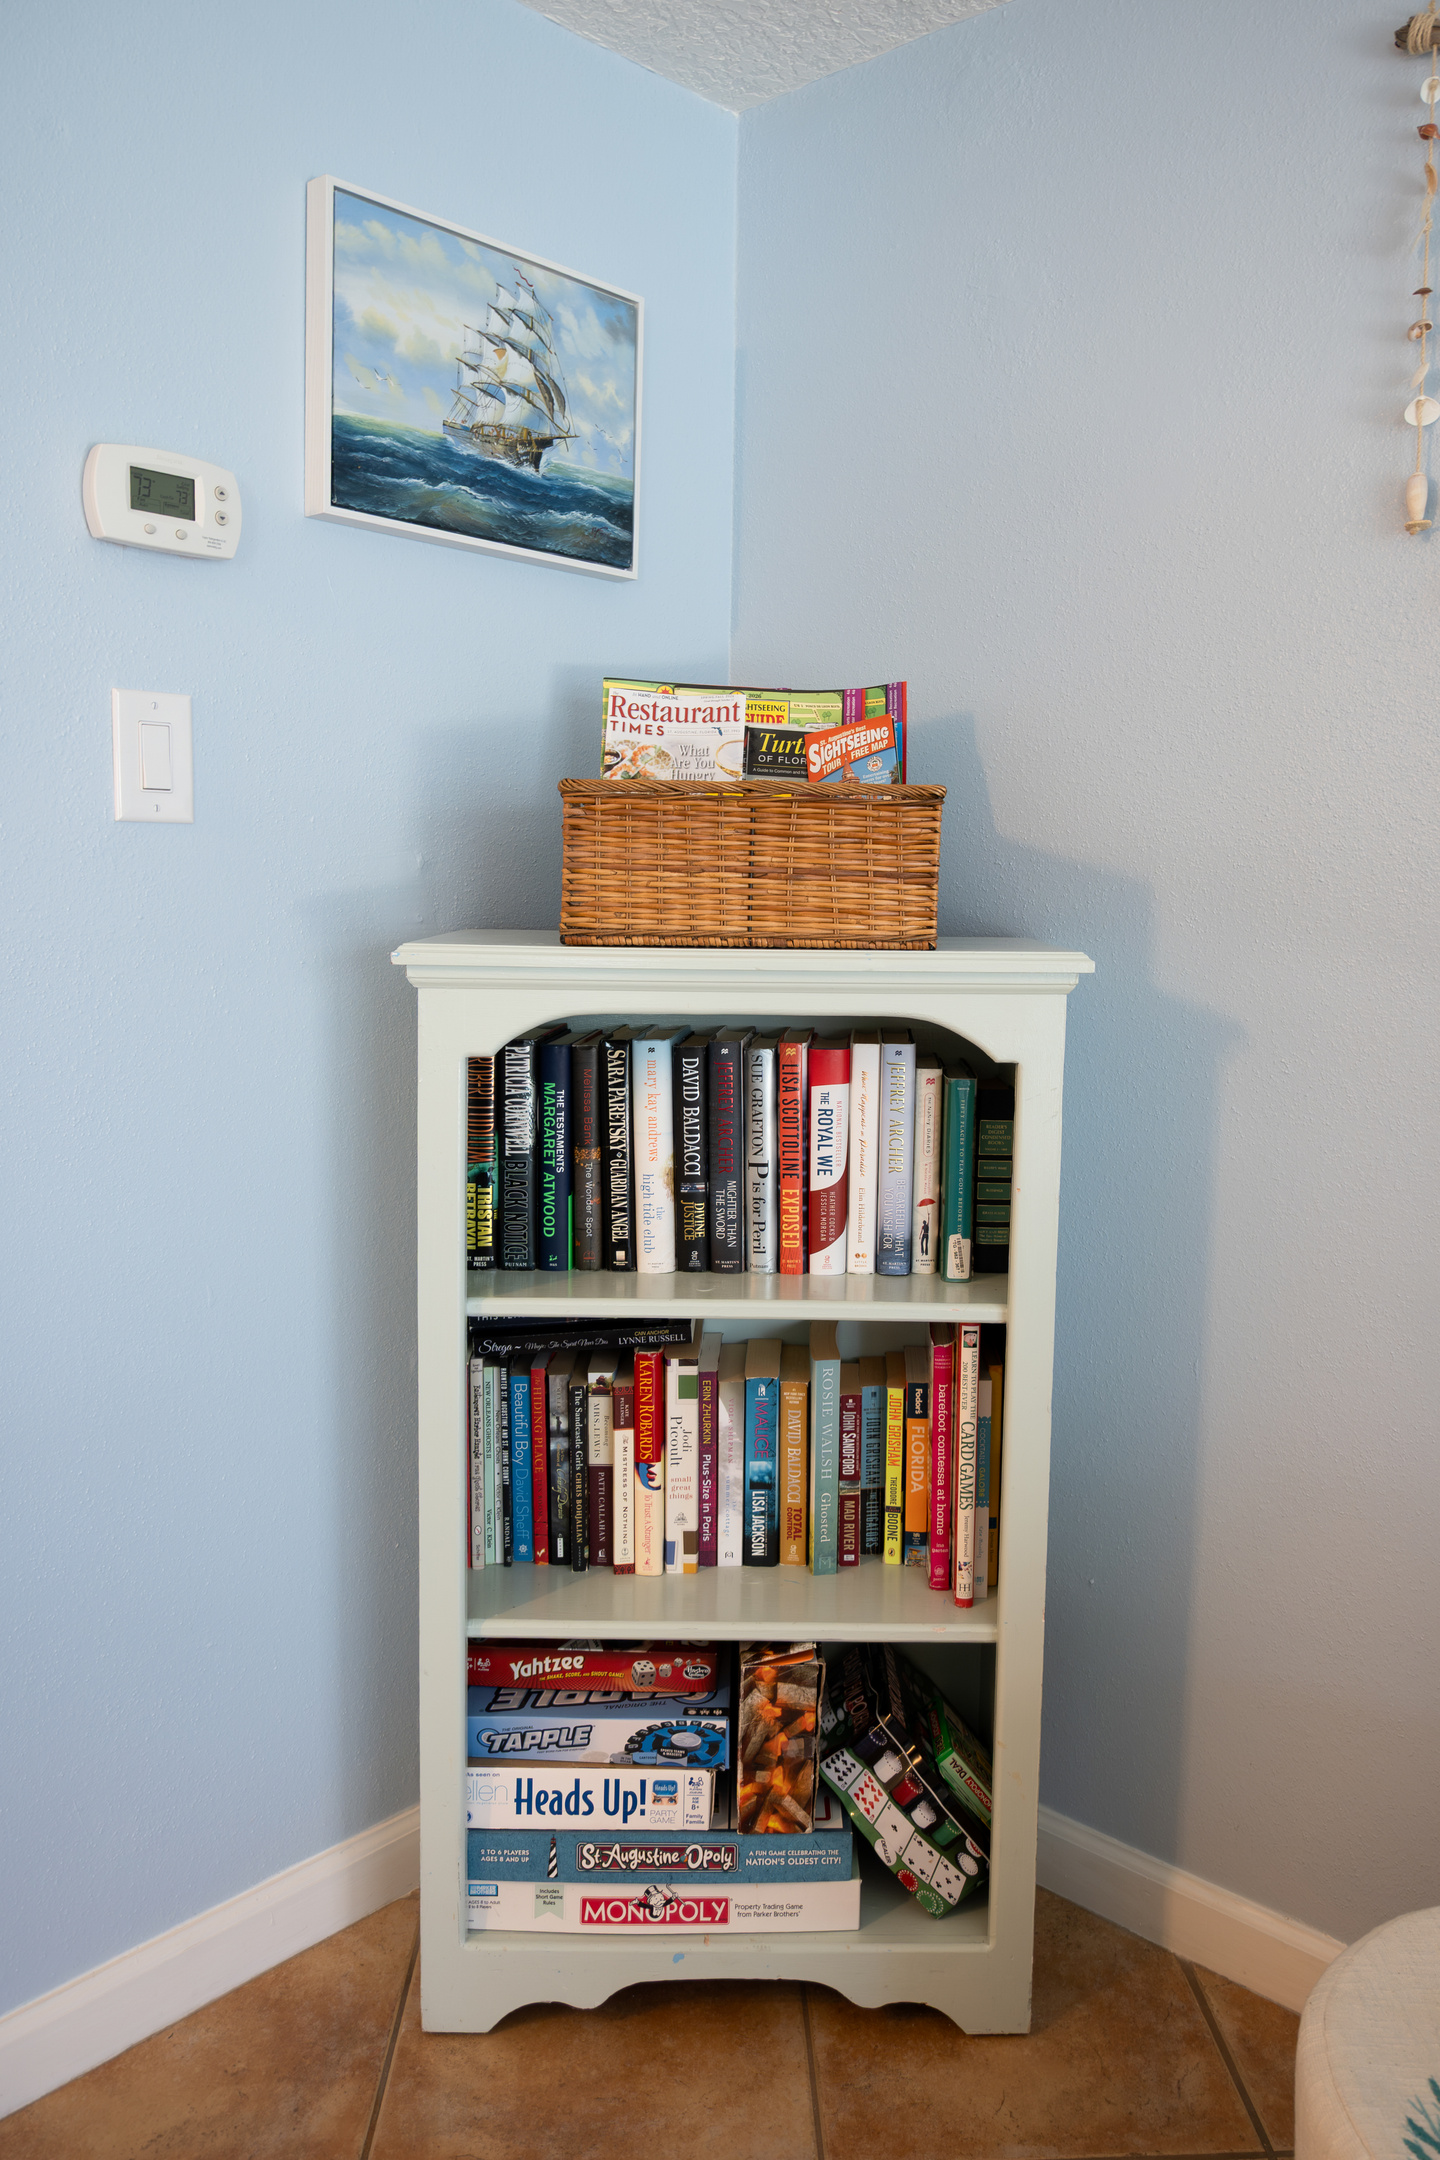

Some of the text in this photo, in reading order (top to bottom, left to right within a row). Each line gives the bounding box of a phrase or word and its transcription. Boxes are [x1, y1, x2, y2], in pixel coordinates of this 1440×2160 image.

[609, 695, 740, 723] Restaurant
[610, 720, 664, 736] TIMES
[678, 745, 709, 757] What
[809, 727, 889, 773] SIGHTSEEING
[828, 730, 855, 744] Augustine's
[855, 725, 866, 733] Best
[850, 740, 888, 760] FREE MAP
[670, 758, 715, 769] Are You
[822, 759, 841, 775] TOUR
[556, 1090, 565, 1173] THE TESTAMENTS
[644, 1060, 661, 1162] mary kay andrews
[886, 1061, 906, 1173] JEFFREY ARCHER
[504, 1046, 531, 1260] PATRICIA CORNWELL BLACK NOTICE
[583, 1069, 594, 1237] Melissa Bank The Wonder Spot
[607, 1049, 629, 1242] SARA PARETSKY GUARDIAN ANGEL
[817, 1092, 833, 1176] THE ROYAL WE
[543, 1082, 555, 1237] MARGARET ATWOOD
[782, 1064, 799, 1248] LISA SCOTTOLINE EXPOSED
[640, 1174, 654, 1254] high tide club
[656, 1207, 665, 1220] the
[858, 1204, 866, 1243] Hilderbrand
[883, 1188, 893, 1248] YOU WISH FOR
[895, 1179, 906, 1257] BE CAREFUL WHAT
[618, 1334, 685, 1345] LYNNE RUSSELL
[575, 1389, 583, 1406] The
[971, 1376, 977, 1386] TO
[575, 1408, 583, 1449] Sandcastle
[639, 1360, 655, 1460] KAREN ROBARDS
[755, 1402, 769, 1458] MALICE
[513, 1383, 529, 1538] Beautiful Boy David Sheff
[574, 1451, 583, 1471] Girls
[670, 1416, 683, 1467] Picoult
[682, 1429, 692, 1452] Jodi
[702, 1380, 711, 1541] ERIN ZHURKIN Plus-Size in Paris
[787, 1409, 802, 1503] DAVID BALDACCI
[820, 1367, 834, 1543] ROSIE WALSH Ghosted
[910, 1426, 925, 1493] FLORIDA
[936, 1384, 948, 1535] barefoot contessa at home
[598, 1472, 606, 1494] PATTI
[842, 1410, 856, 1550] JOHN SANDFORD MAD RIVER
[887, 1394, 902, 1541] JOHN GRISHAM THEODORE BOONE
[959, 1421, 976, 1510] CARD GAMES
[751, 1491, 766, 1556] LISA JACKSON
[793, 1507, 802, 1540] TOTAL
[509, 1655, 584, 1680] Yahtzee
[488, 1725, 593, 1753] TAPPLE
[950, 1758, 967, 1779] DEAL
[515, 1778, 646, 1824] Heads Up!
[480, 1855, 497, 1863] AGES
[503, 1849, 529, 1857] PLAYERS
[580, 1844, 734, 1871] St. Augustine Opoly
[745, 1858, 785, 1866] NATION'S
[820, 1857, 841, 1865] CITY!
[881, 1840, 892, 1864] DEALER
[584, 1901, 726, 1923] MONOPOLY
[734, 1904, 760, 1912] Property
[762, 1904, 787, 1912] Trading
